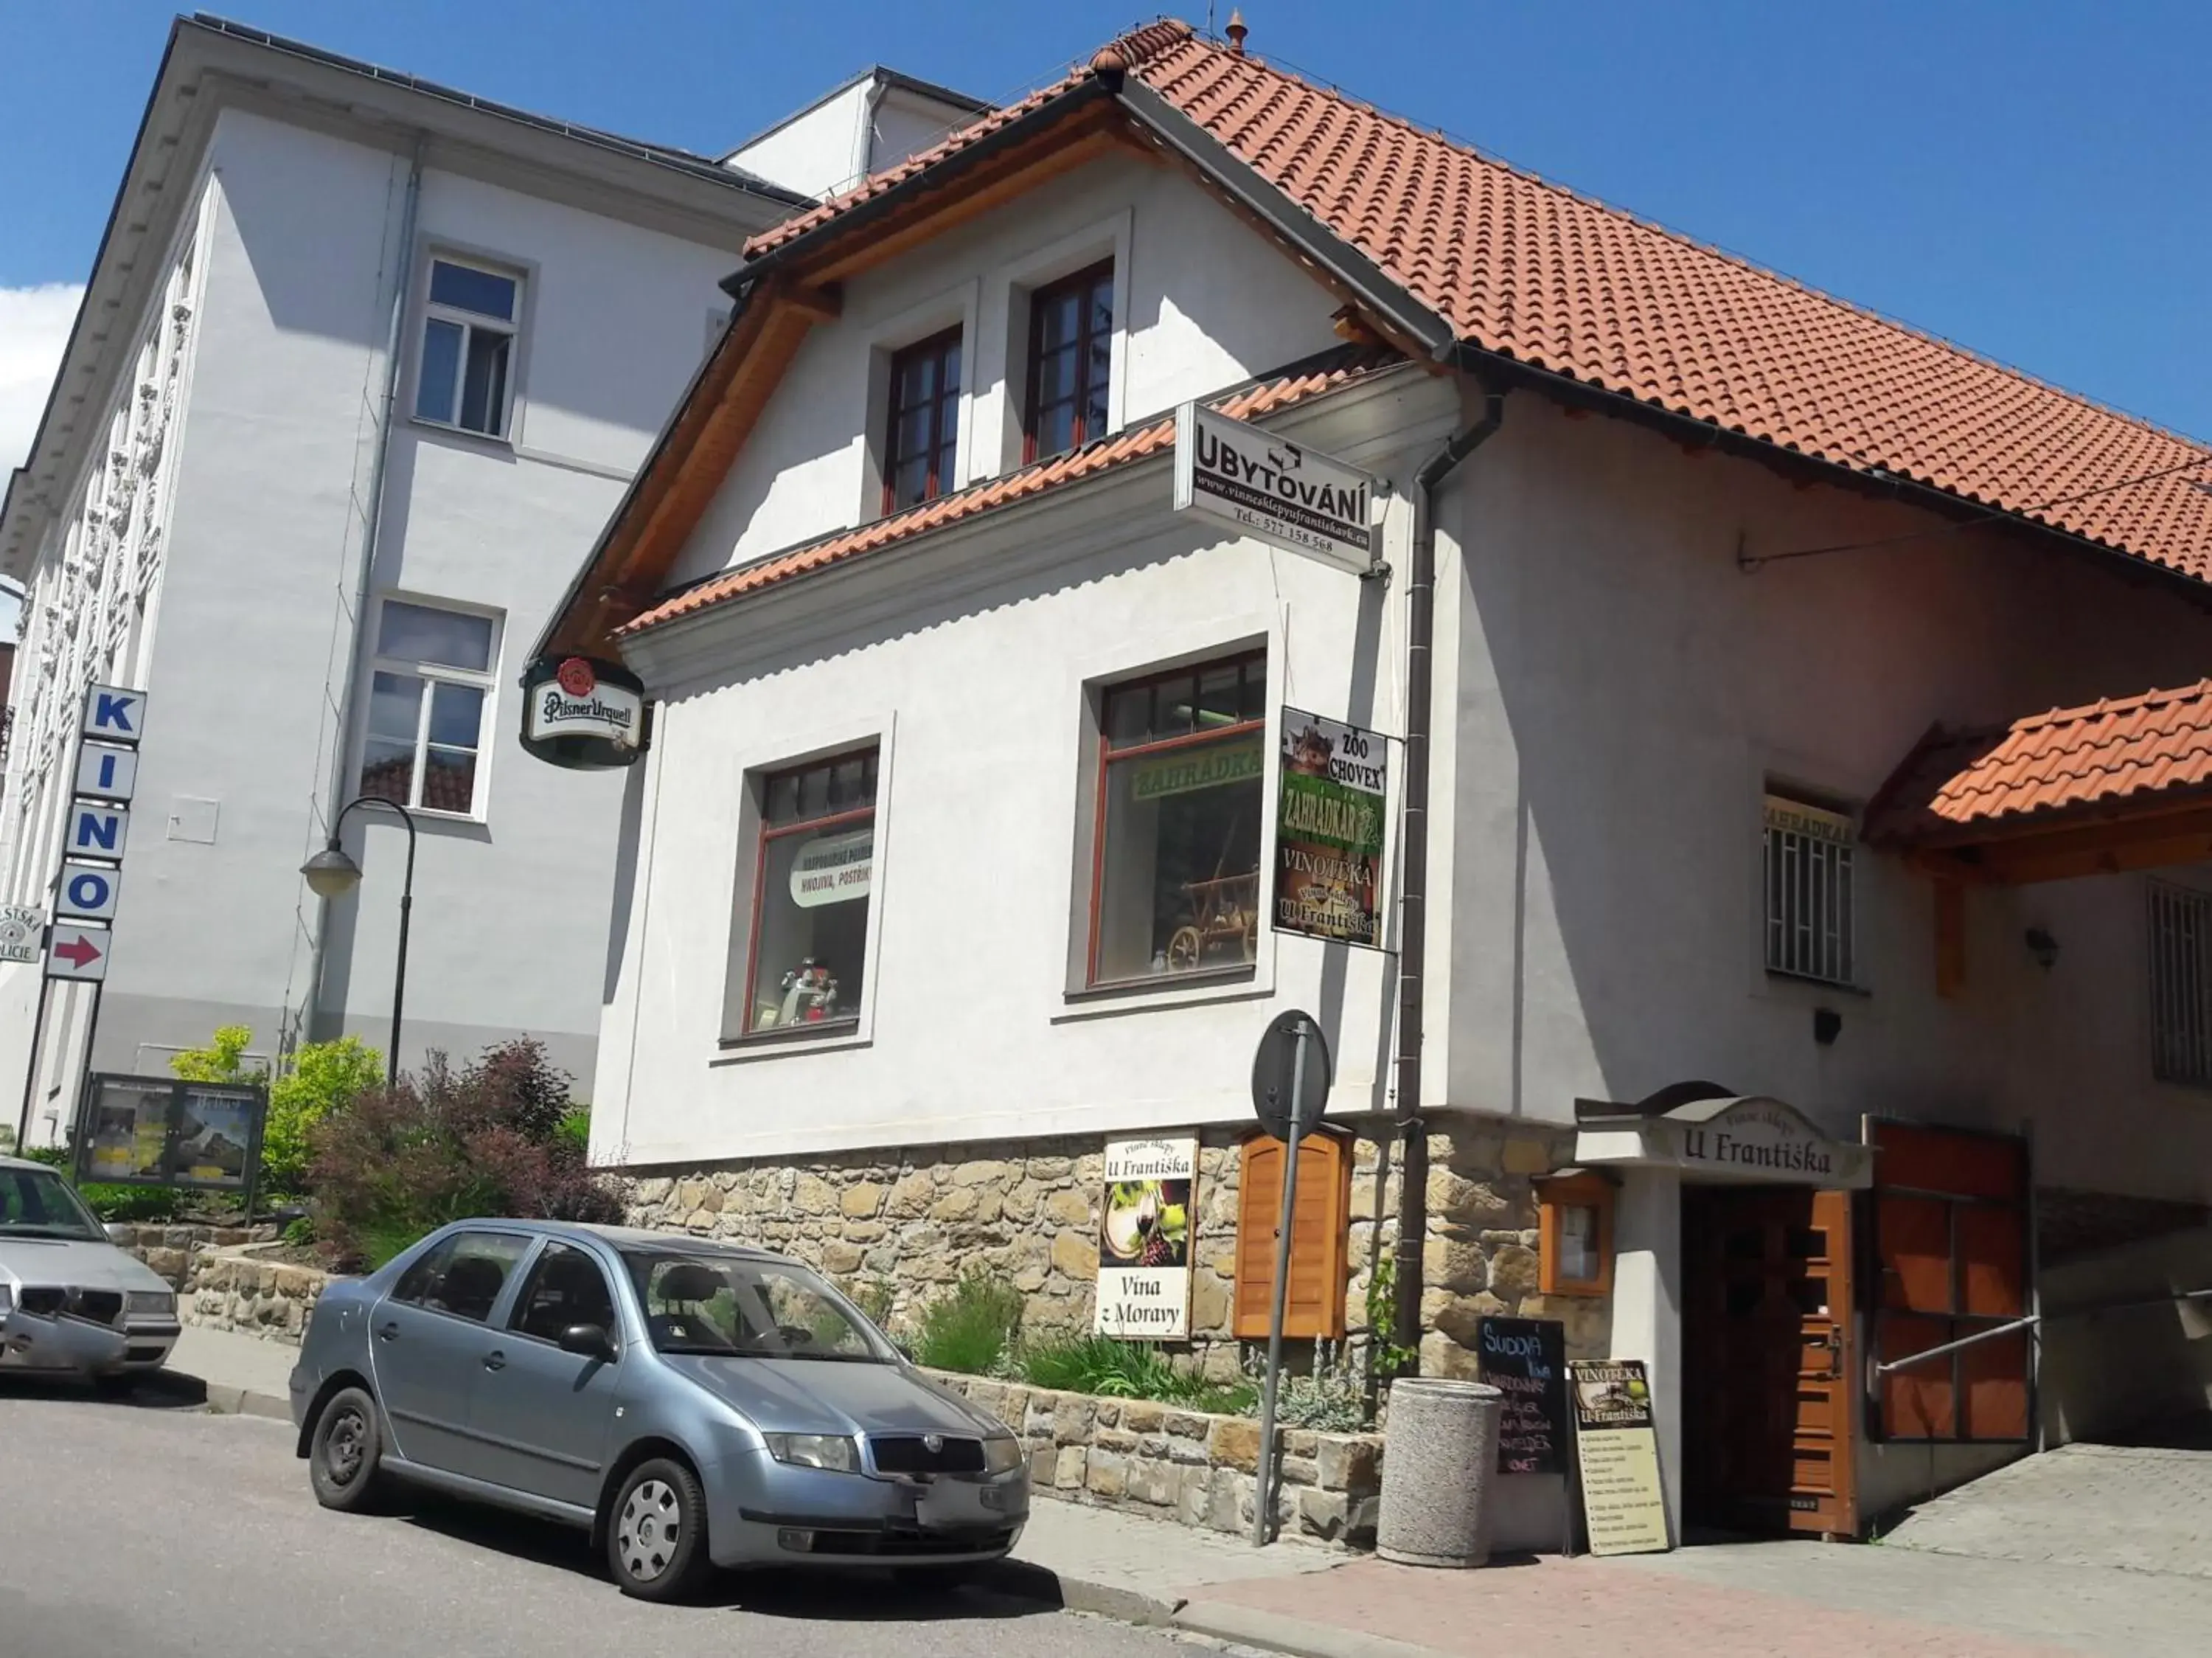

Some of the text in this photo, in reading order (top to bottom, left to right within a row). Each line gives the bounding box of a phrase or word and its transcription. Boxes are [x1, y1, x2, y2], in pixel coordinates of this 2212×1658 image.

[1197, 423, 1366, 525] UBYTOVÁNÍ
[1263, 518, 1284, 535] 577
[1290, 527, 1309, 544] 158
[543, 691, 632, 726] Pilsner Urquell
[1343, 733, 1368, 758] ZOO
[1329, 757, 1381, 791] CHOVEX
[1108, 1155, 1189, 1176] U Františka
[1684, 1128, 1833, 1176] U Františka
[1121, 1274, 1161, 1296] Vína
[1114, 1303, 1180, 1333] Moravy
